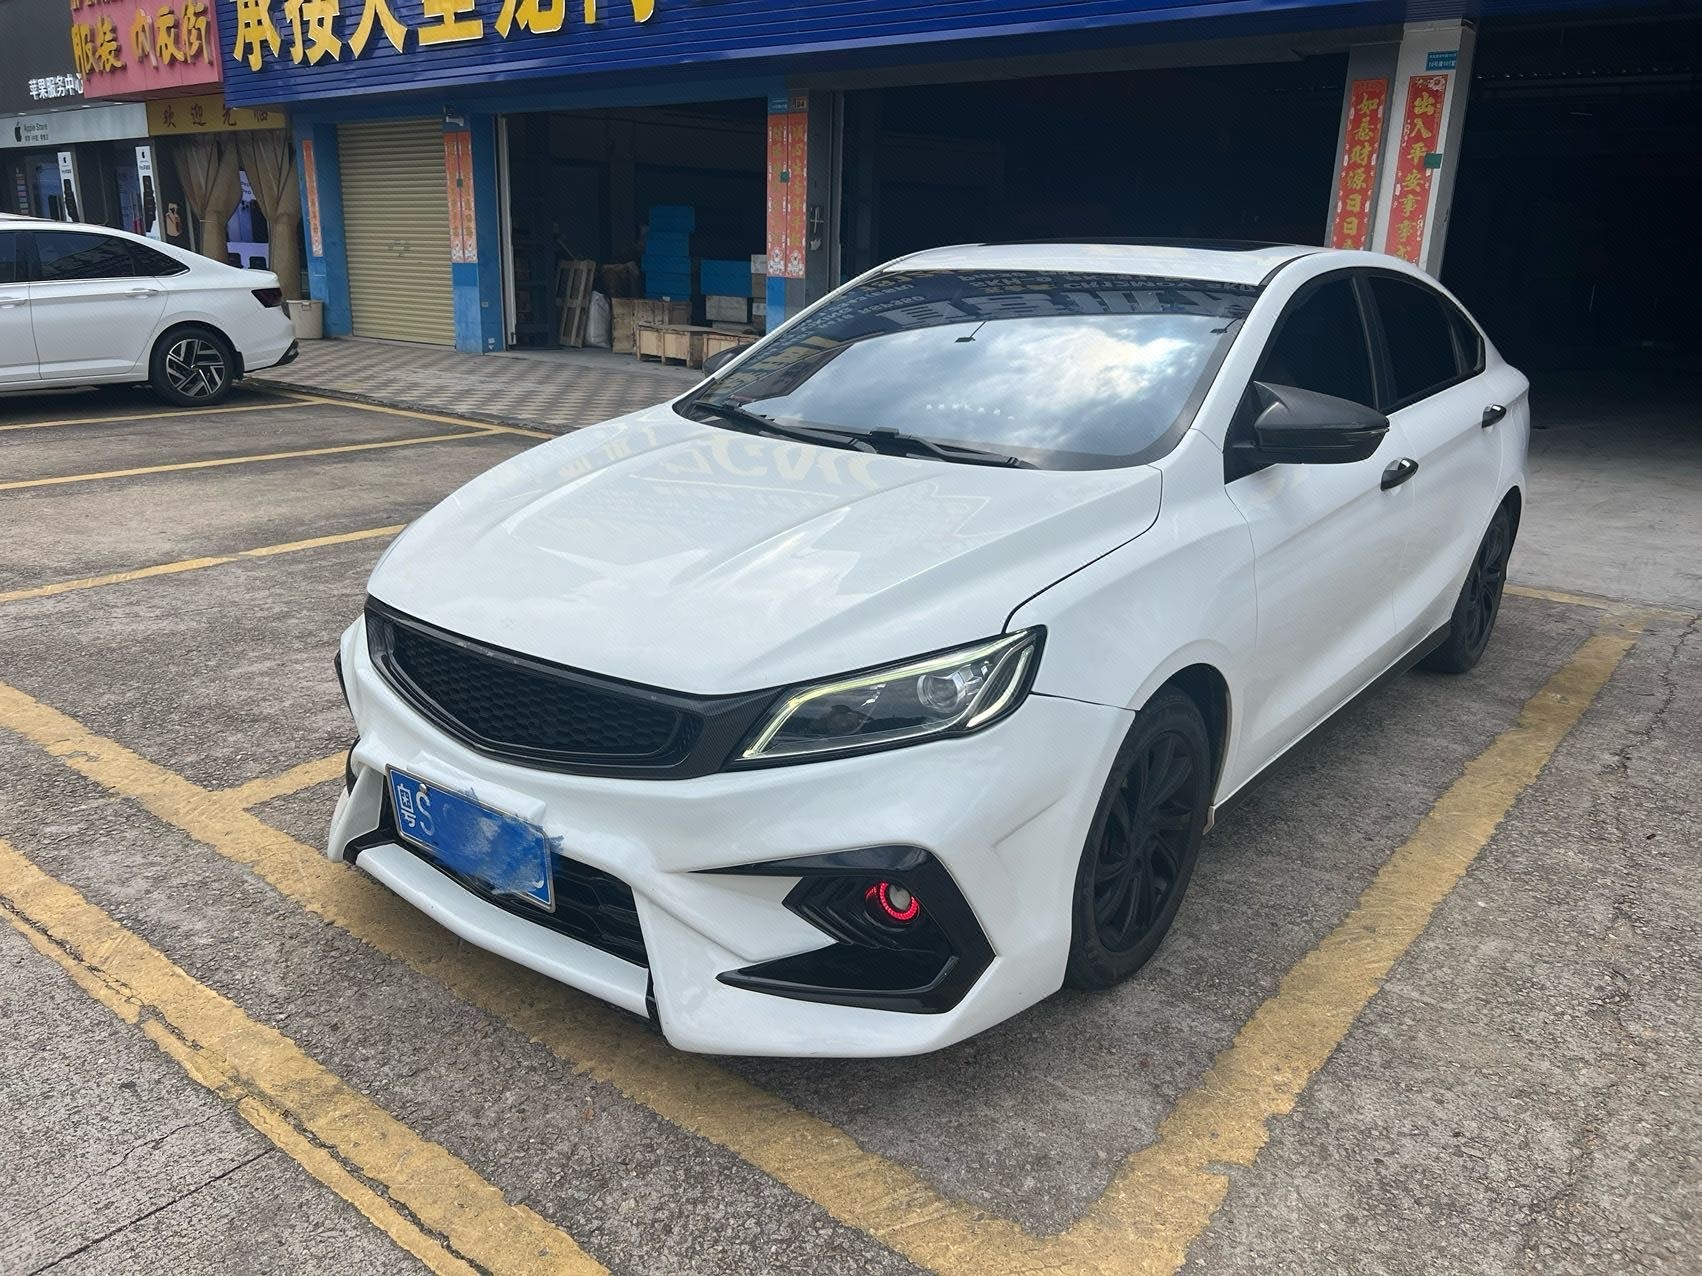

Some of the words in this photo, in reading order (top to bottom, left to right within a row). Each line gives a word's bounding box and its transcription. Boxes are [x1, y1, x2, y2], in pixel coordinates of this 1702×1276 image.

[28, 73, 84, 100] 苹果服务中心
